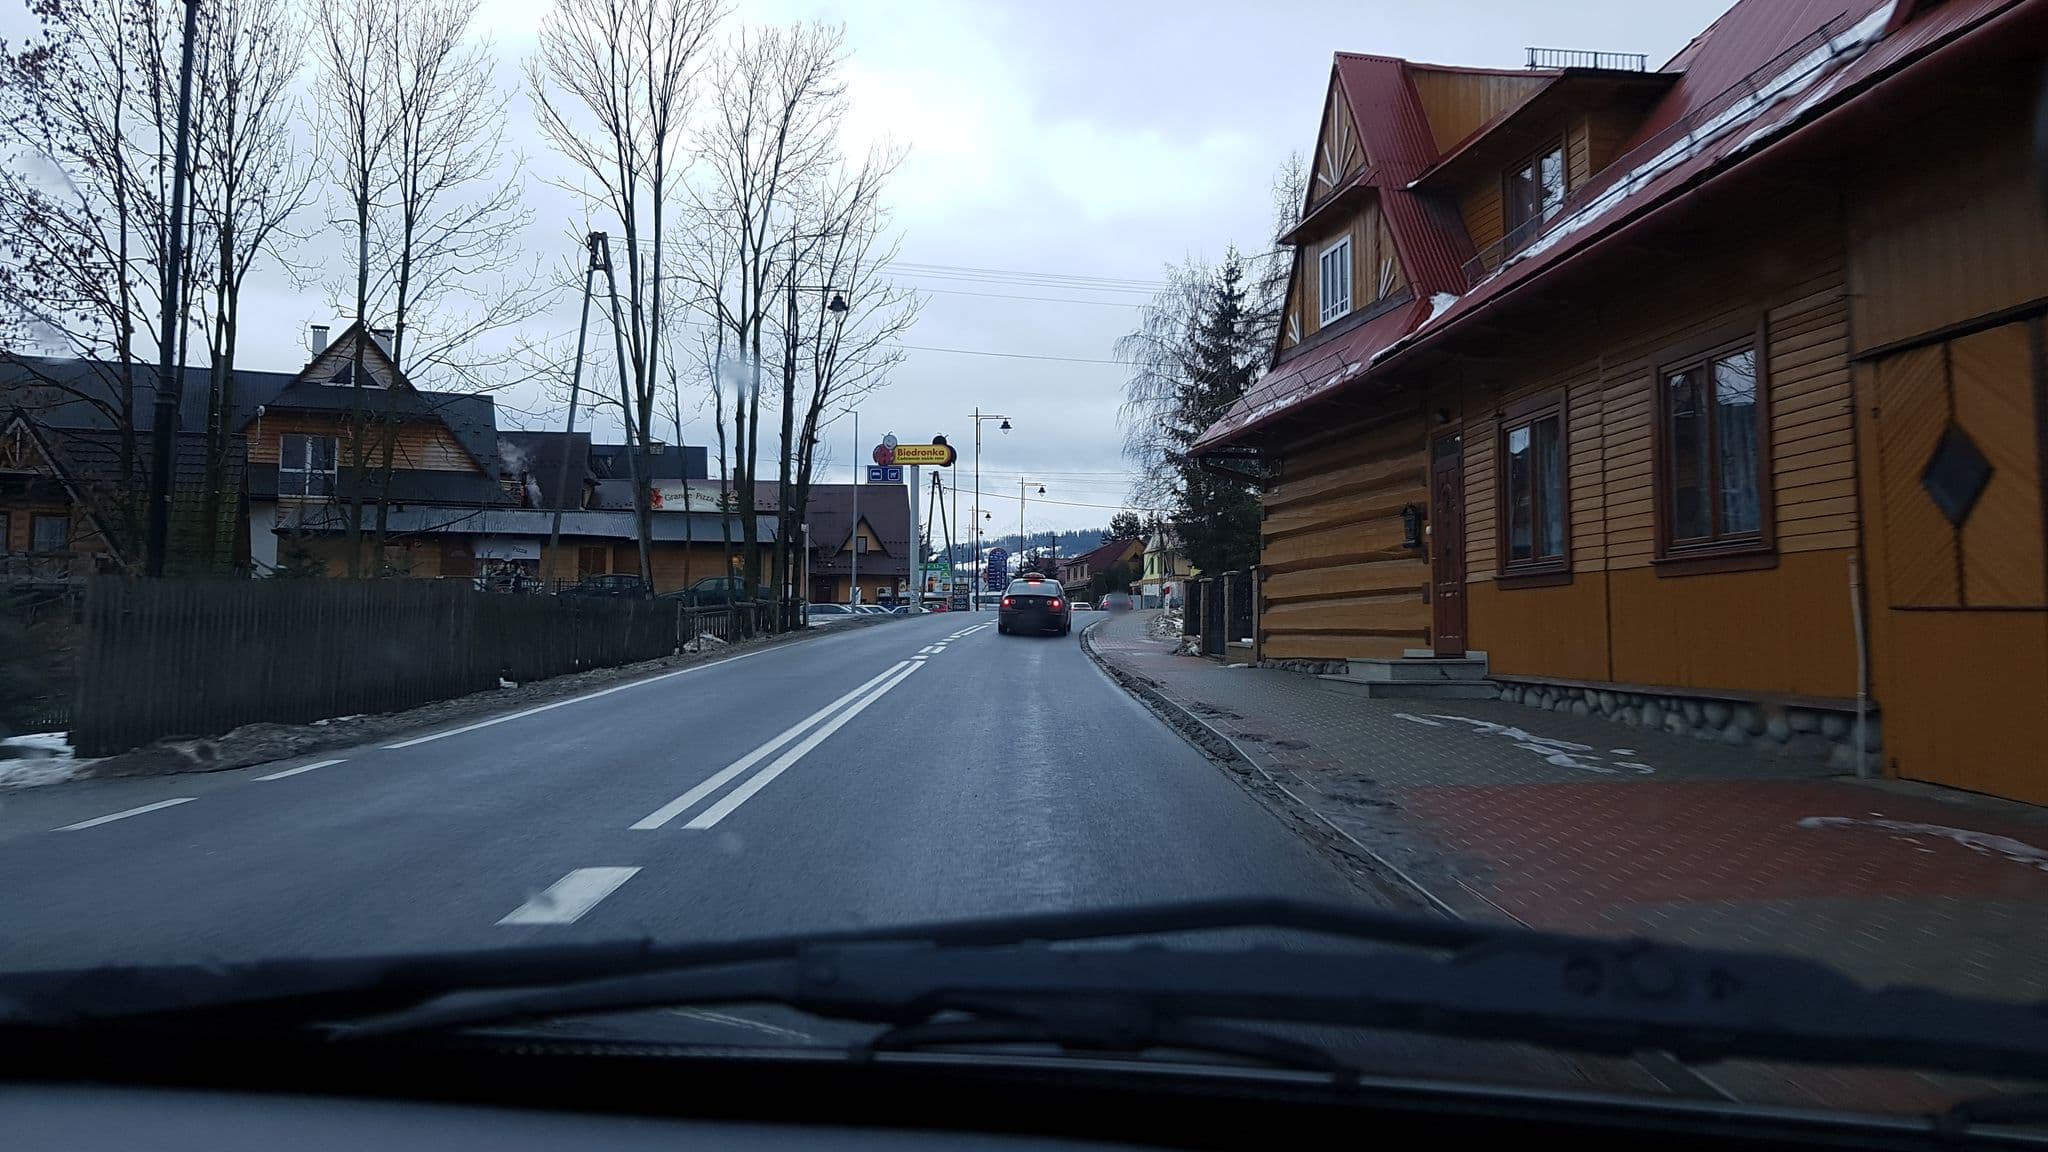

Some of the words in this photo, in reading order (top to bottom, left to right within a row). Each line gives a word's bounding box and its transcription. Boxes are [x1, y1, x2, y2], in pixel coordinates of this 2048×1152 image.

[897, 448, 945, 456] Biedronka
[664, 493, 693, 501] Grane
[695, 492, 714, 502] Pizza
